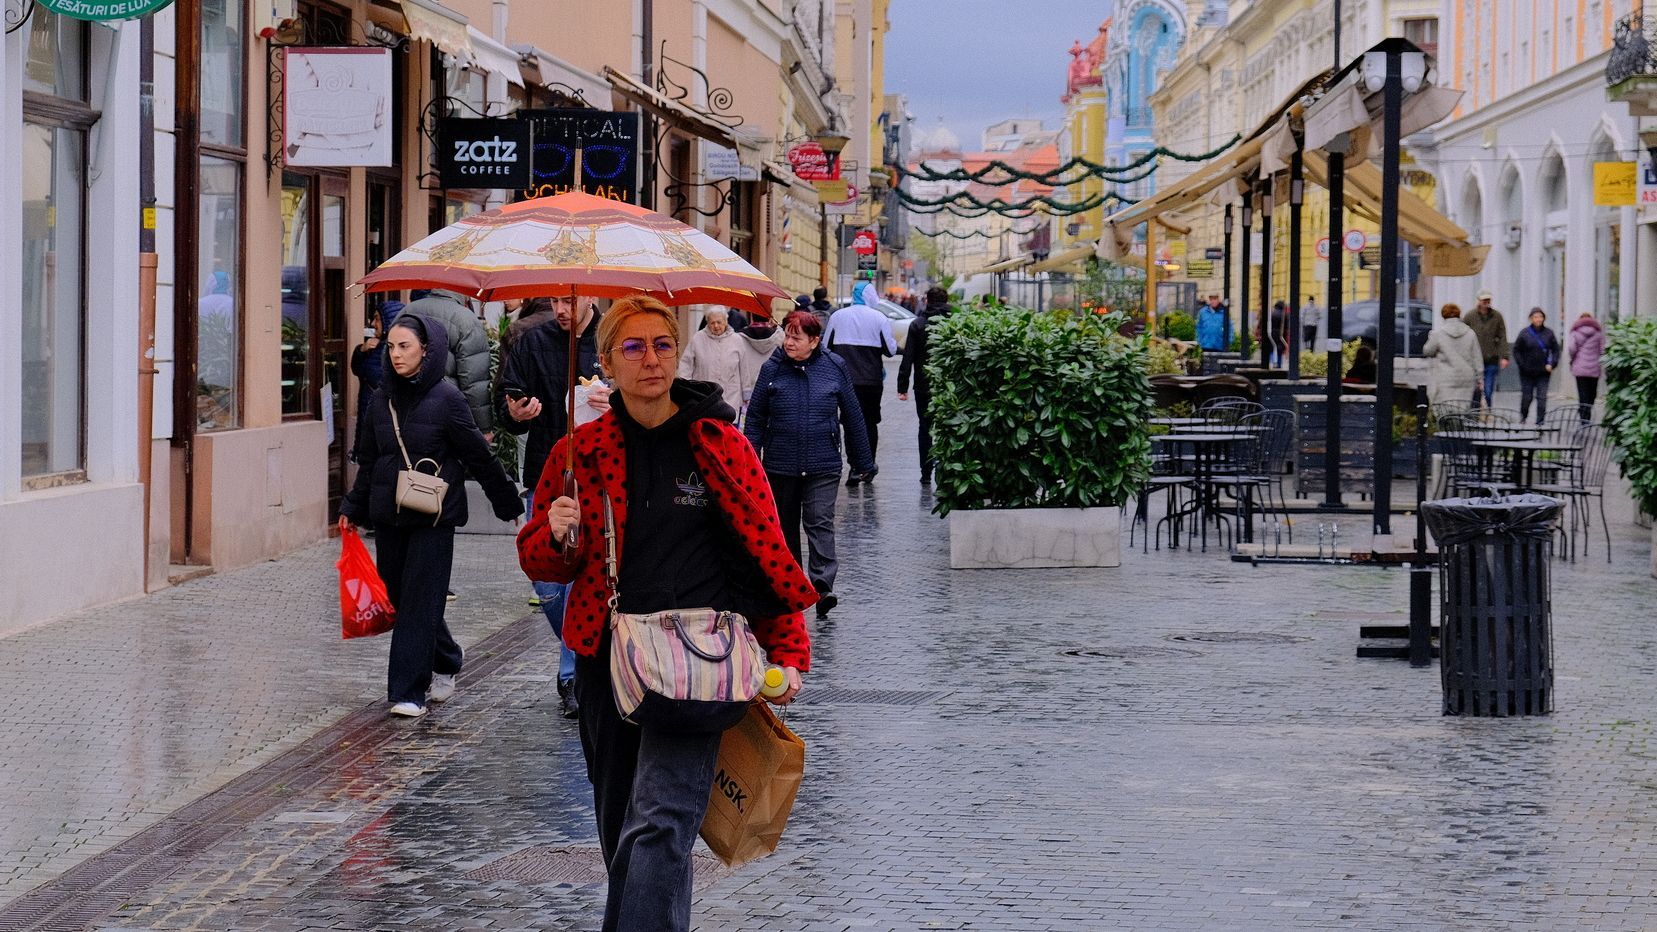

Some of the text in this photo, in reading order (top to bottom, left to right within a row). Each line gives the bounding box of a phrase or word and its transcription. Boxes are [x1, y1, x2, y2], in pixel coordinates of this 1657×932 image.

[110, 4, 126, 15] DE
[453, 135, 518, 163] zatz
[460, 165, 511, 175] COFFEE
[714, 768, 748, 814] NSK.
